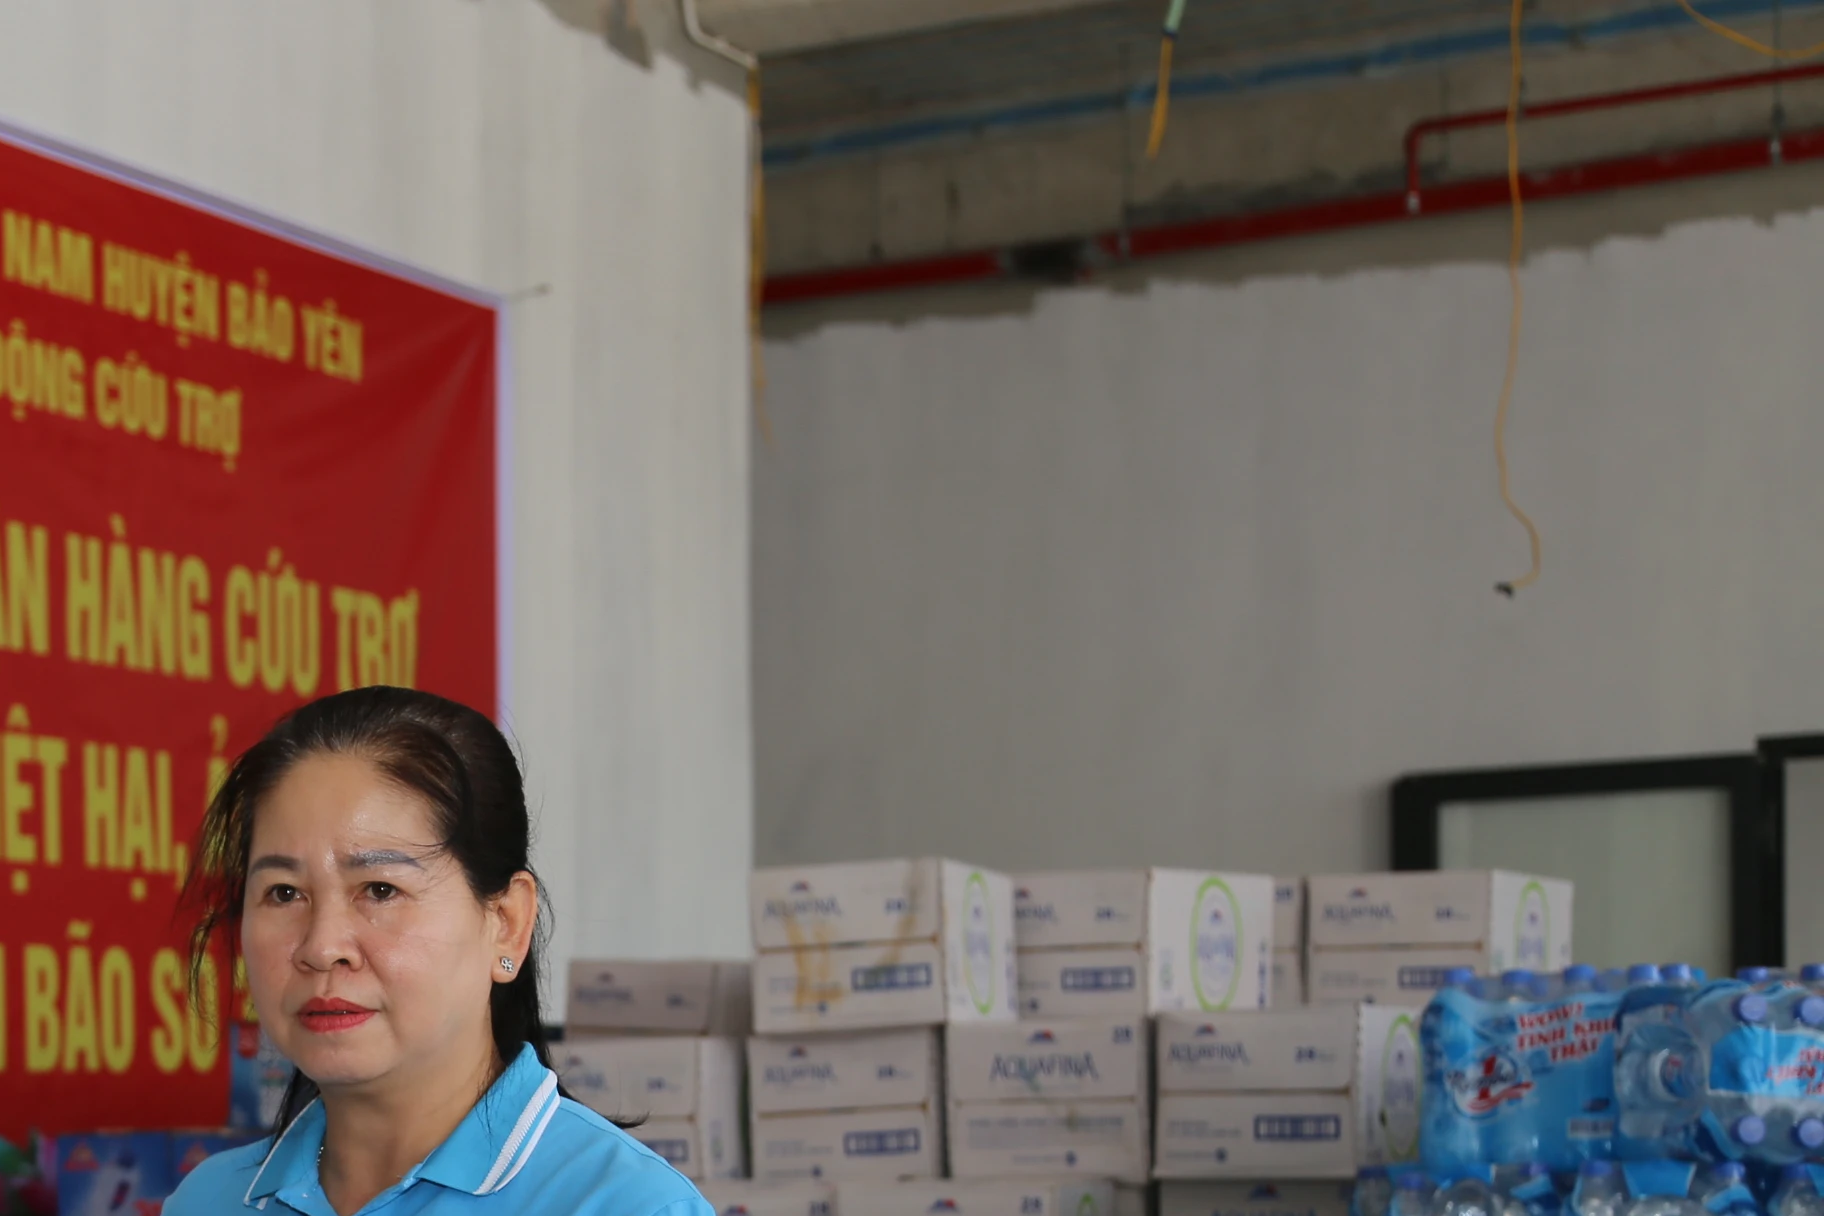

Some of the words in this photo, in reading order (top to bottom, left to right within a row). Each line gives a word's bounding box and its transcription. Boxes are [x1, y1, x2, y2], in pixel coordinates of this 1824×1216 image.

[2, 211, 94, 301] NAM
[103, 244, 219, 344] HUYỆN
[227, 283, 294, 361] BẢO
[302, 308, 362, 380] YÊN
[94, 358, 168, 439] CỨU
[175, 380, 241, 469] TRỢ
[65, 514, 212, 679] HÀNG
[224, 549, 321, 697] CỨU
[24, 921, 135, 1072] BÃO
